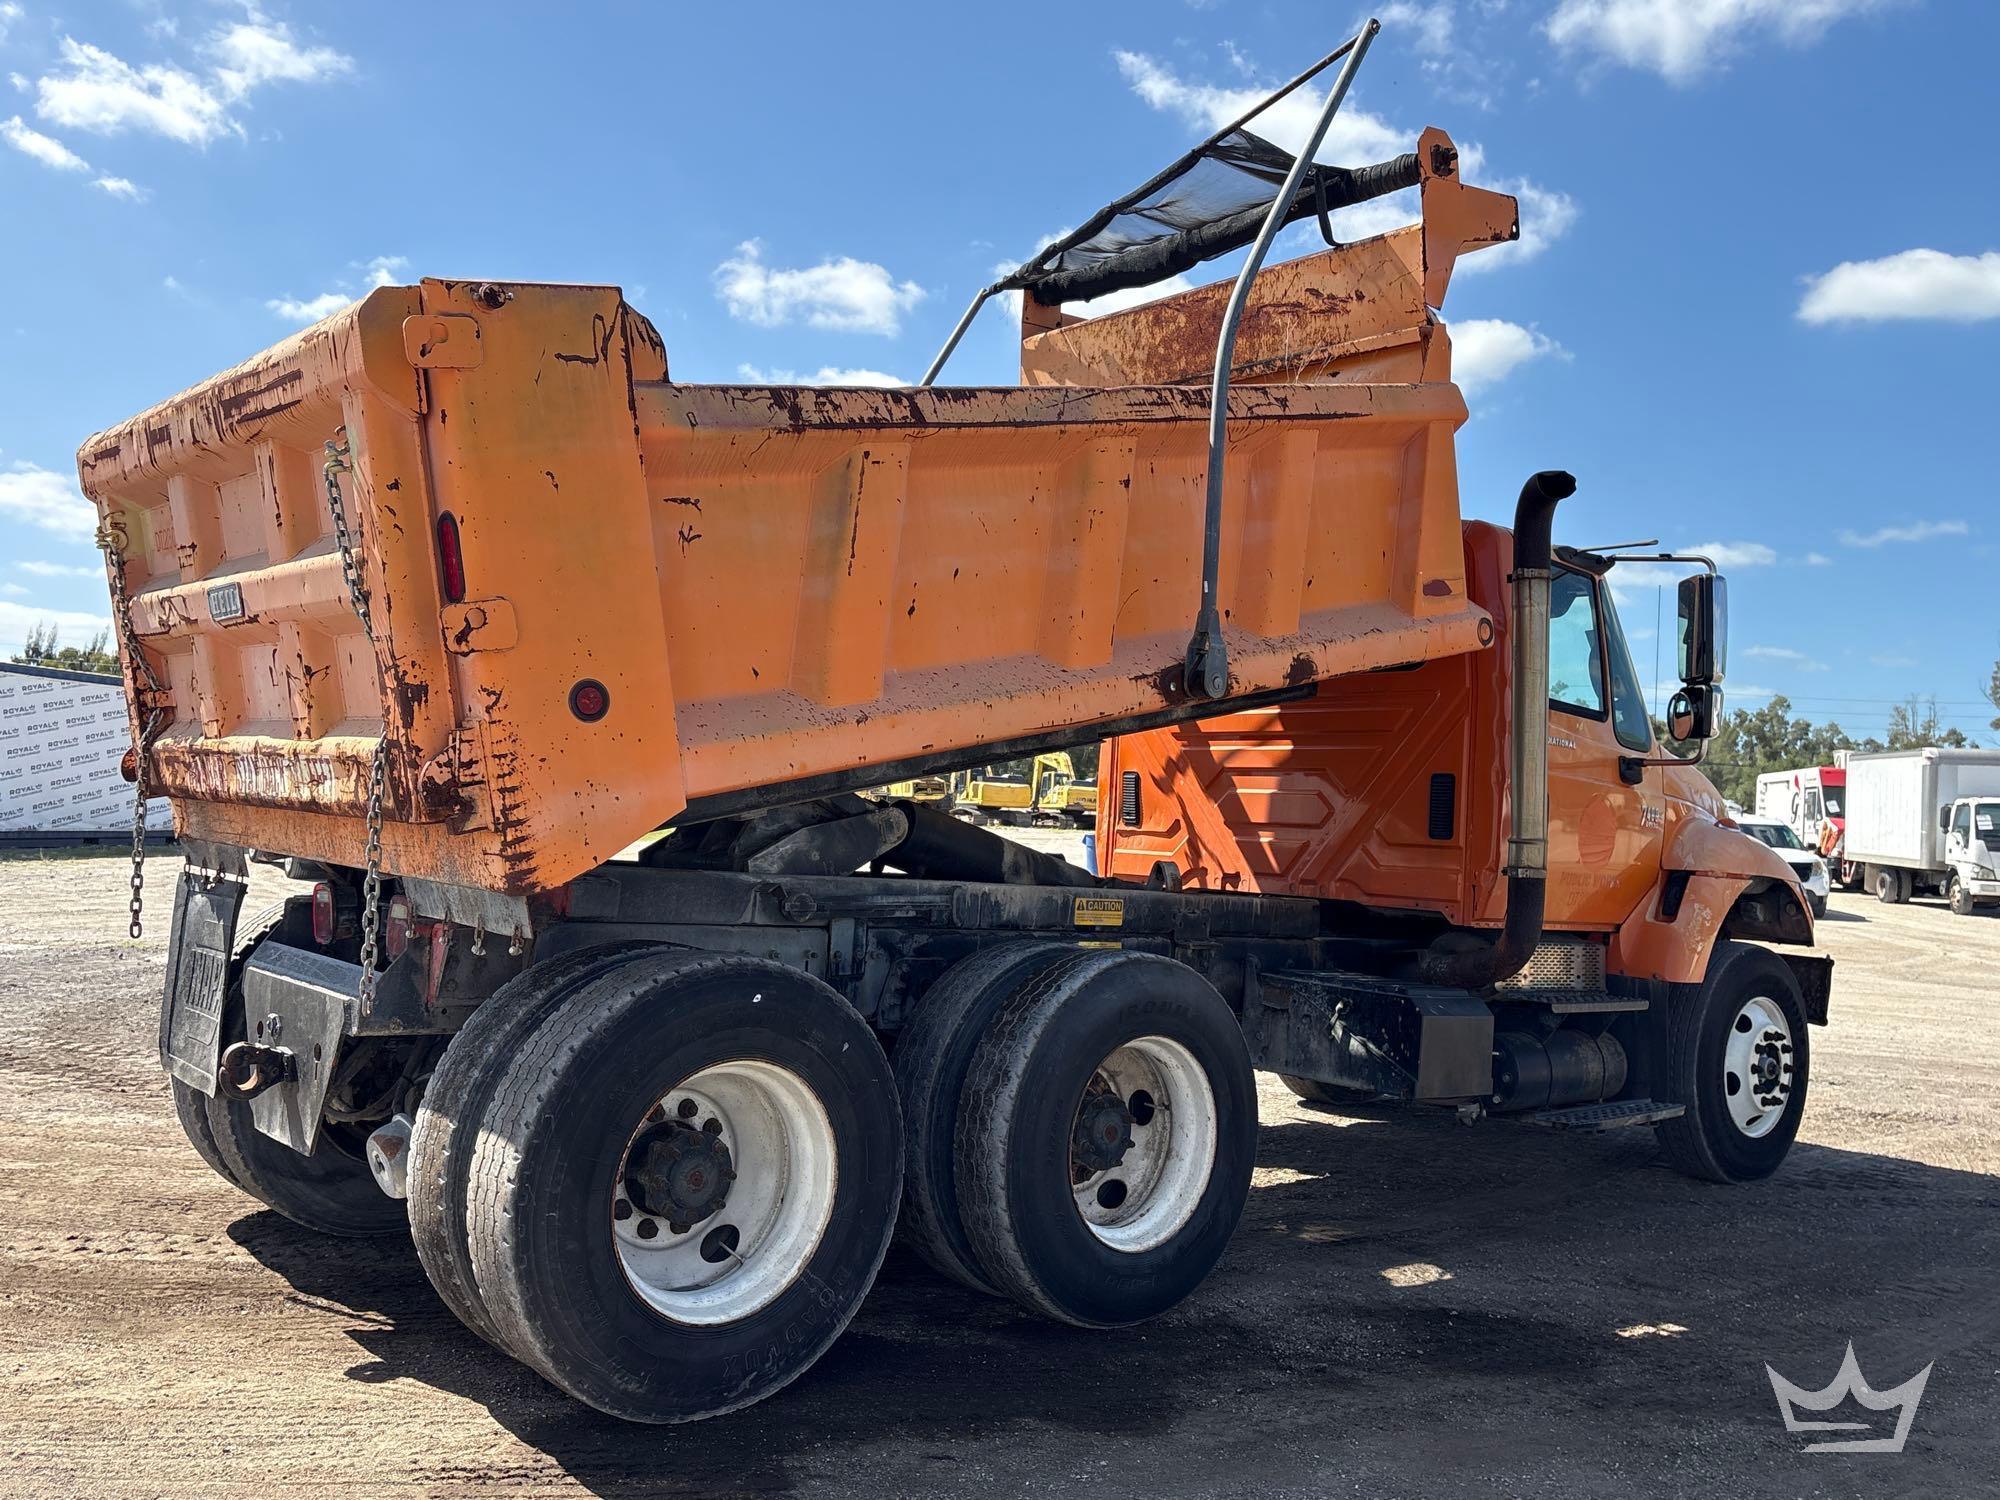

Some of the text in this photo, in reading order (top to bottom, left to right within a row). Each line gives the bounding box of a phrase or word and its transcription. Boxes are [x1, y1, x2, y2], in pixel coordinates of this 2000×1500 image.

[81, 694, 104, 702] ROYAL
[43, 700, 67, 708] ROYAL
[3, 706, 29, 715] ROYAL
[103, 709, 124, 717] ROYAL
[66, 716, 89, 724] ROYAL
[27, 723, 52, 731] ROYAL
[86, 732, 108, 740] ROYAL
[48, 739, 72, 747] ROYAL
[1547, 736, 1576, 749] NATIONAL
[7, 746, 33, 755] ROYAL
[106, 746, 127, 754] ROYAL
[70, 754, 93, 762] ROYAL
[31, 761, 56, 770] ROYAL
[89, 769, 111, 777] ROYAL
[50, 777, 75, 786] ROYAL
[9, 786, 35, 795] ROYAL
[109, 783, 130, 791] ROYAL
[72, 791, 95, 800] ROYAL
[33, 800, 57, 810] ROYAL
[90, 806, 113, 815] ROYAL
[52, 815, 75, 824] ROYAL
[1087, 901, 1121, 911] CAUTION
